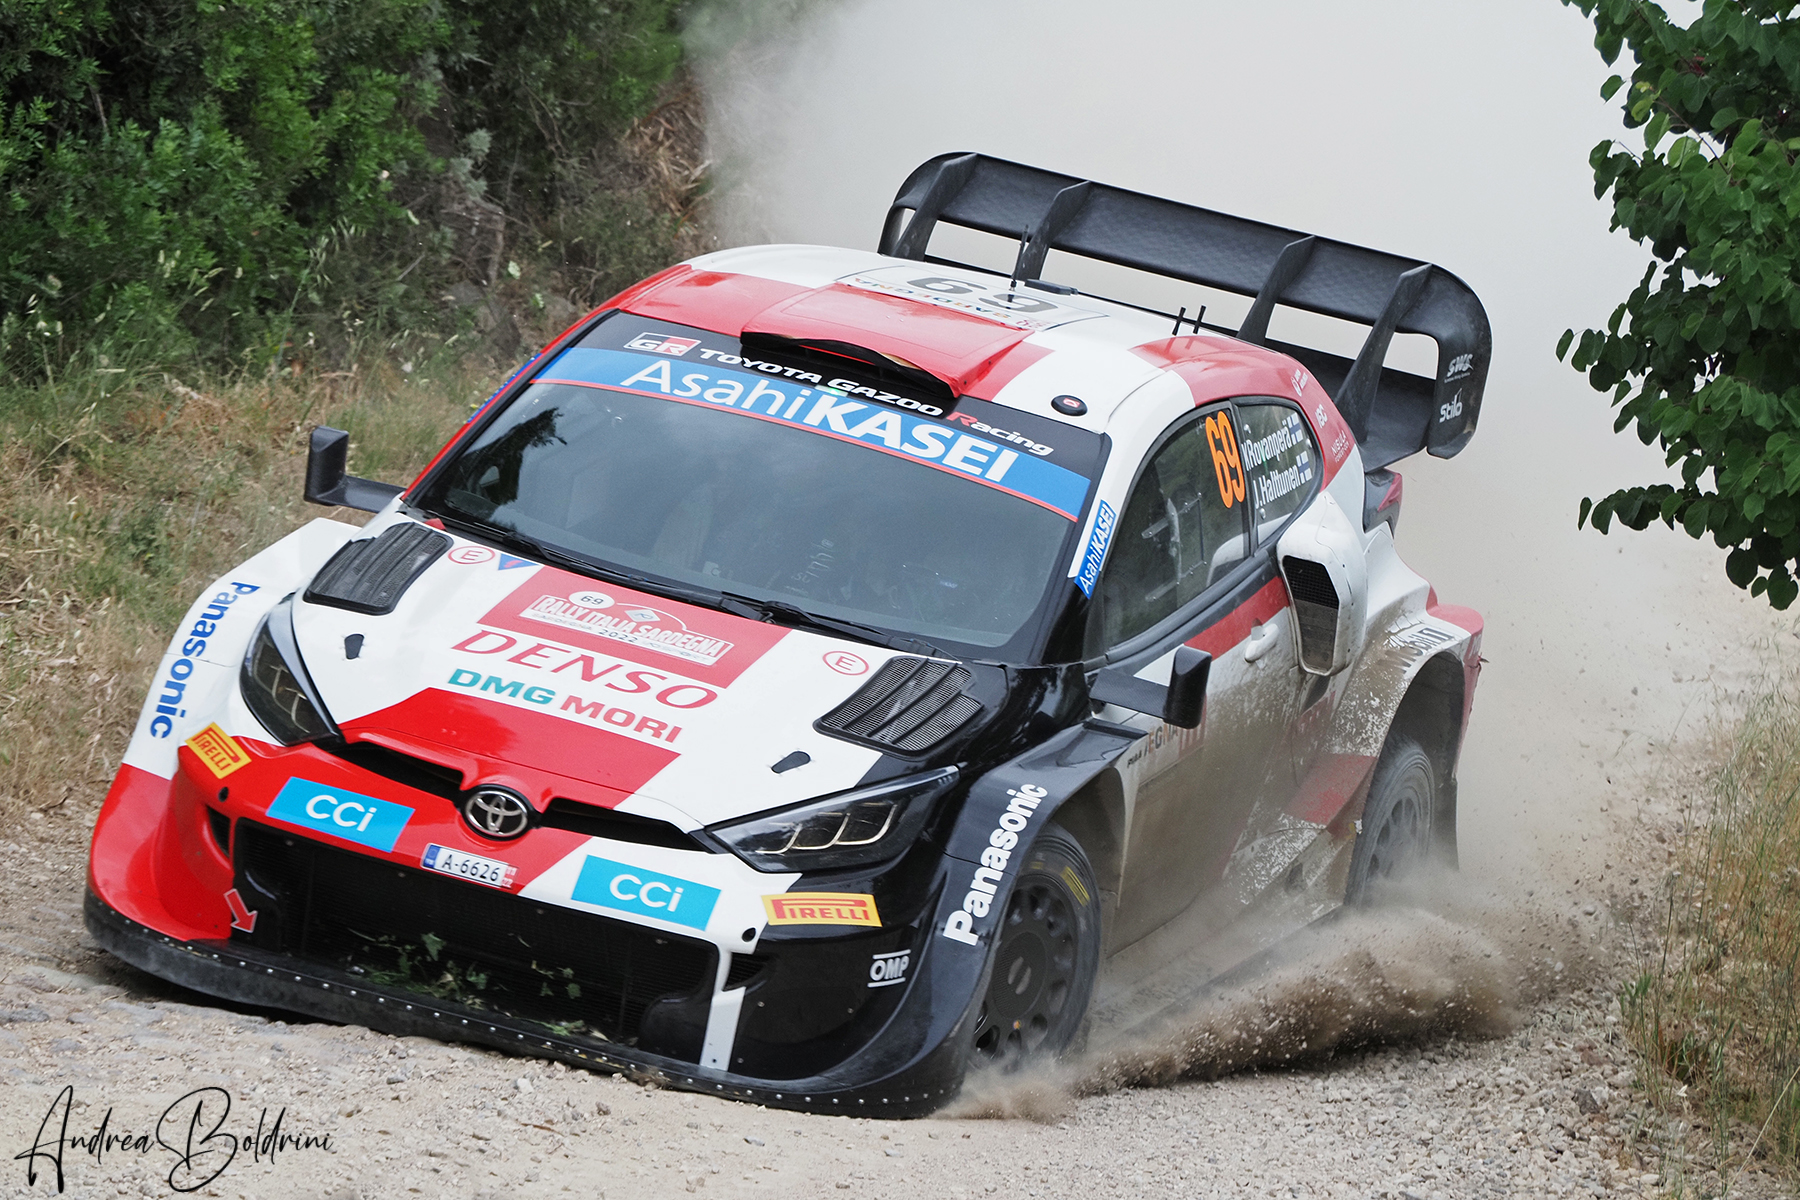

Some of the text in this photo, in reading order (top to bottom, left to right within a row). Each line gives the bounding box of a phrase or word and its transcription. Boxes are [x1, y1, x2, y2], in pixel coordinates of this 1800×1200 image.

[906, 277, 1059, 313] 69
[633, 337, 1055, 456] GR TOYOTA GAZOO Racing
[1439, 388, 1463, 423] Stilo
[620, 359, 1020, 483] AsahiKASEI
[1205, 410, 1246, 509] 69
[1079, 503, 1115, 595] AsahiKASEI
[580, 595, 604, 606] 69
[535, 596, 587, 621] RALLY
[584, 608, 637, 635] ITALIA
[633, 624, 727, 658] SARDEGNA
[598, 628, 639, 643] 2022
[150, 581, 261, 740] Panasonic
[452, 629, 719, 709] DENSO
[448, 668, 682, 744] DMG MORI
[191, 727, 242, 771] PIRELLI
[306, 795, 378, 832] CCi
[441, 853, 501, 882] A-6626
[943, 783, 1048, 947] Panasonic
[609, 873, 684, 913] CCi
[771, 898, 871, 921] PIRELLI
[869, 955, 910, 981] OMP
